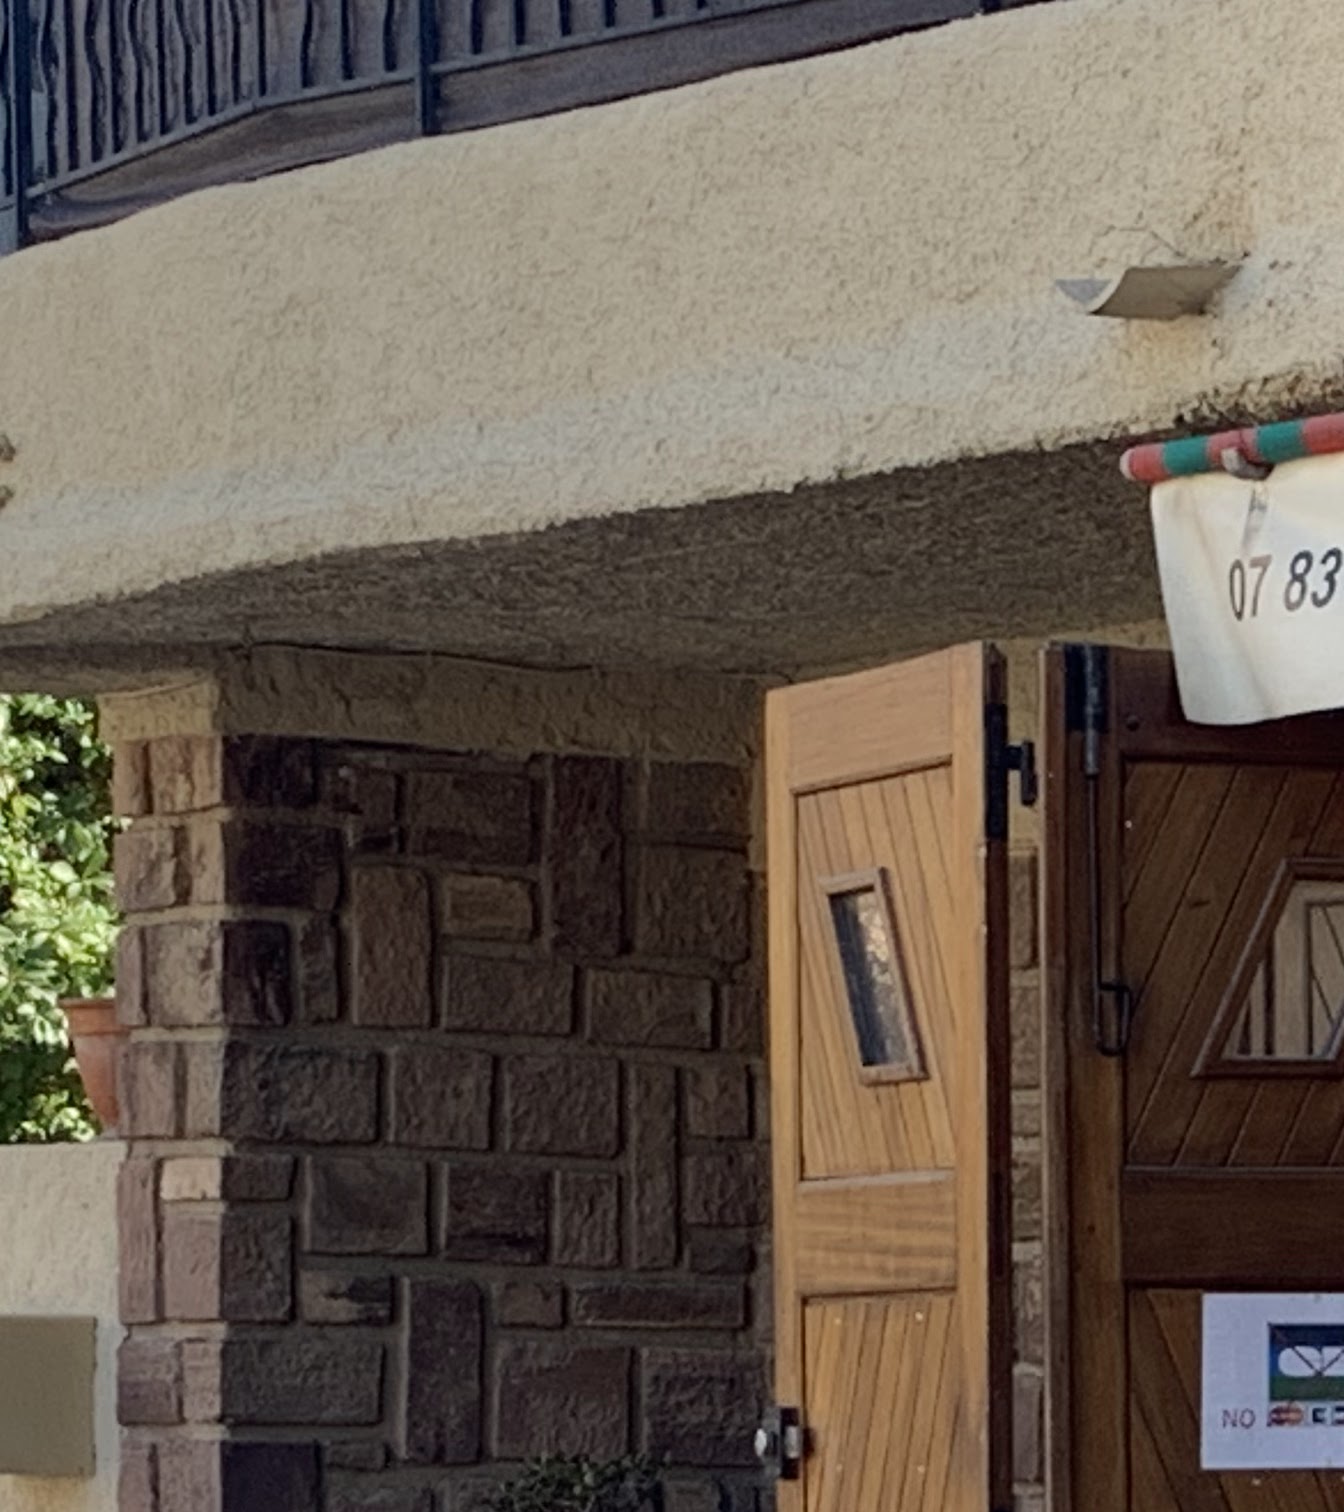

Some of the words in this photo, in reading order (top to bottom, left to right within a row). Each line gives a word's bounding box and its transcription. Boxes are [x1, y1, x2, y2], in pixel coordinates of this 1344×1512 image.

[1229, 554, 1272, 621] 07
[1284, 548, 1343, 612] 83
[1221, 1408, 1256, 1429] NO
